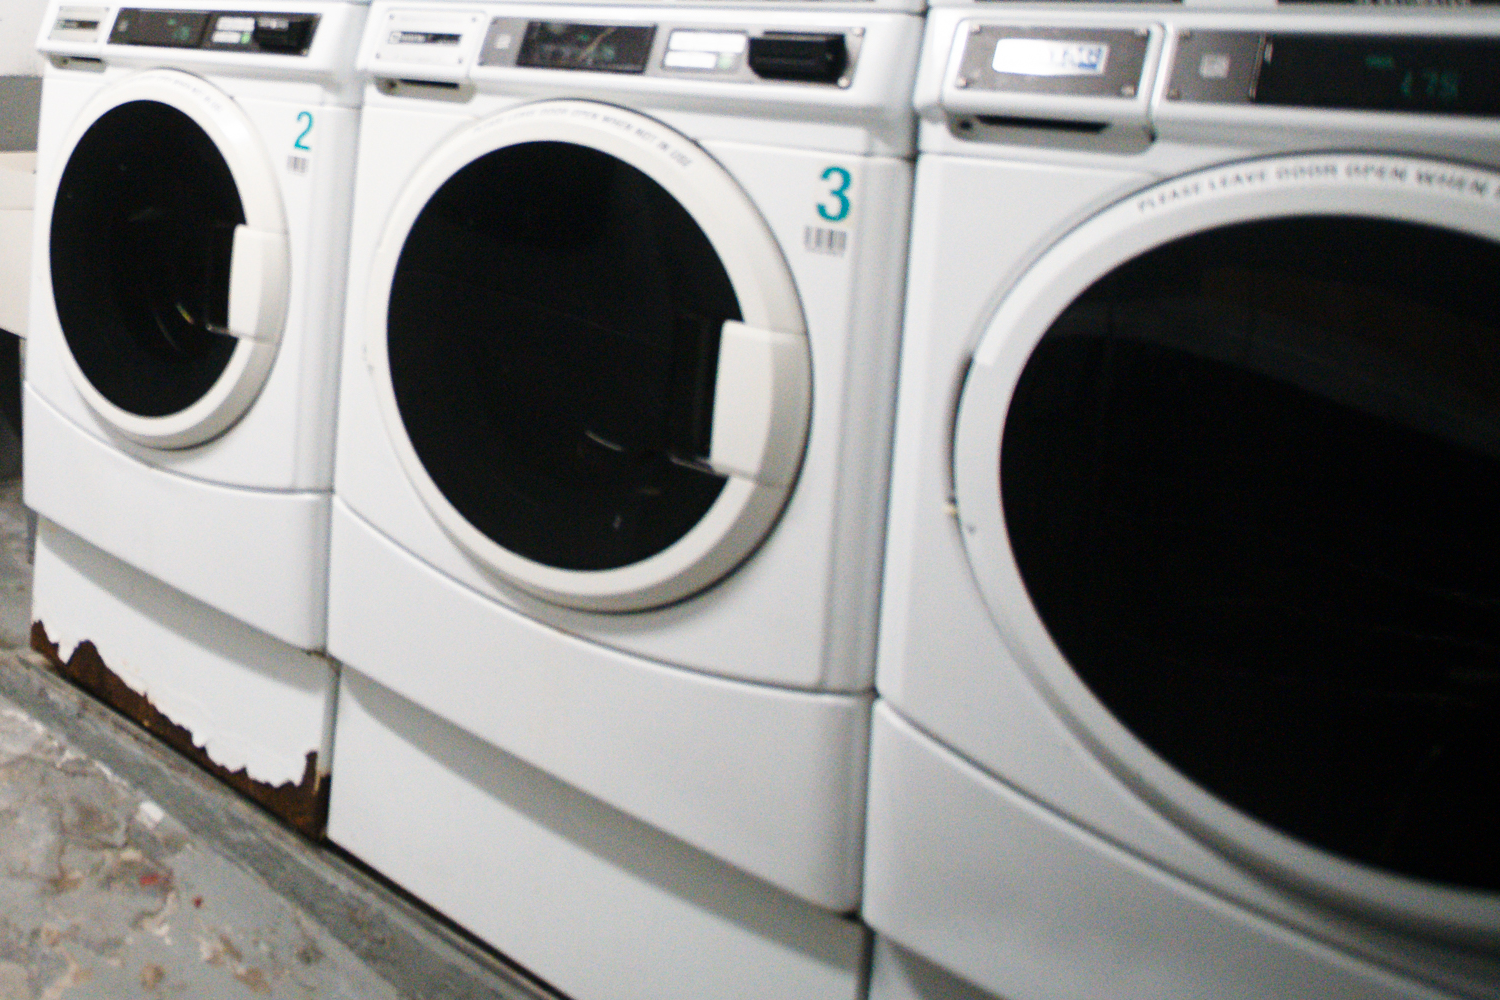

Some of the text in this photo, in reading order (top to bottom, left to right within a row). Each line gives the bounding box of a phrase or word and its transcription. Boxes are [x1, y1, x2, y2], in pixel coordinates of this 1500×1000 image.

[293, 110, 314, 153] 2
[816, 166, 851, 222] 3
[1138, 182, 1201, 211] PLEASE
[1208, 169, 1266, 191] LEAVE
[1276, 163, 1339, 180] DOOR
[1345, 163, 1407, 181] OPEN
[1415, 171, 1489, 197] WHEN
